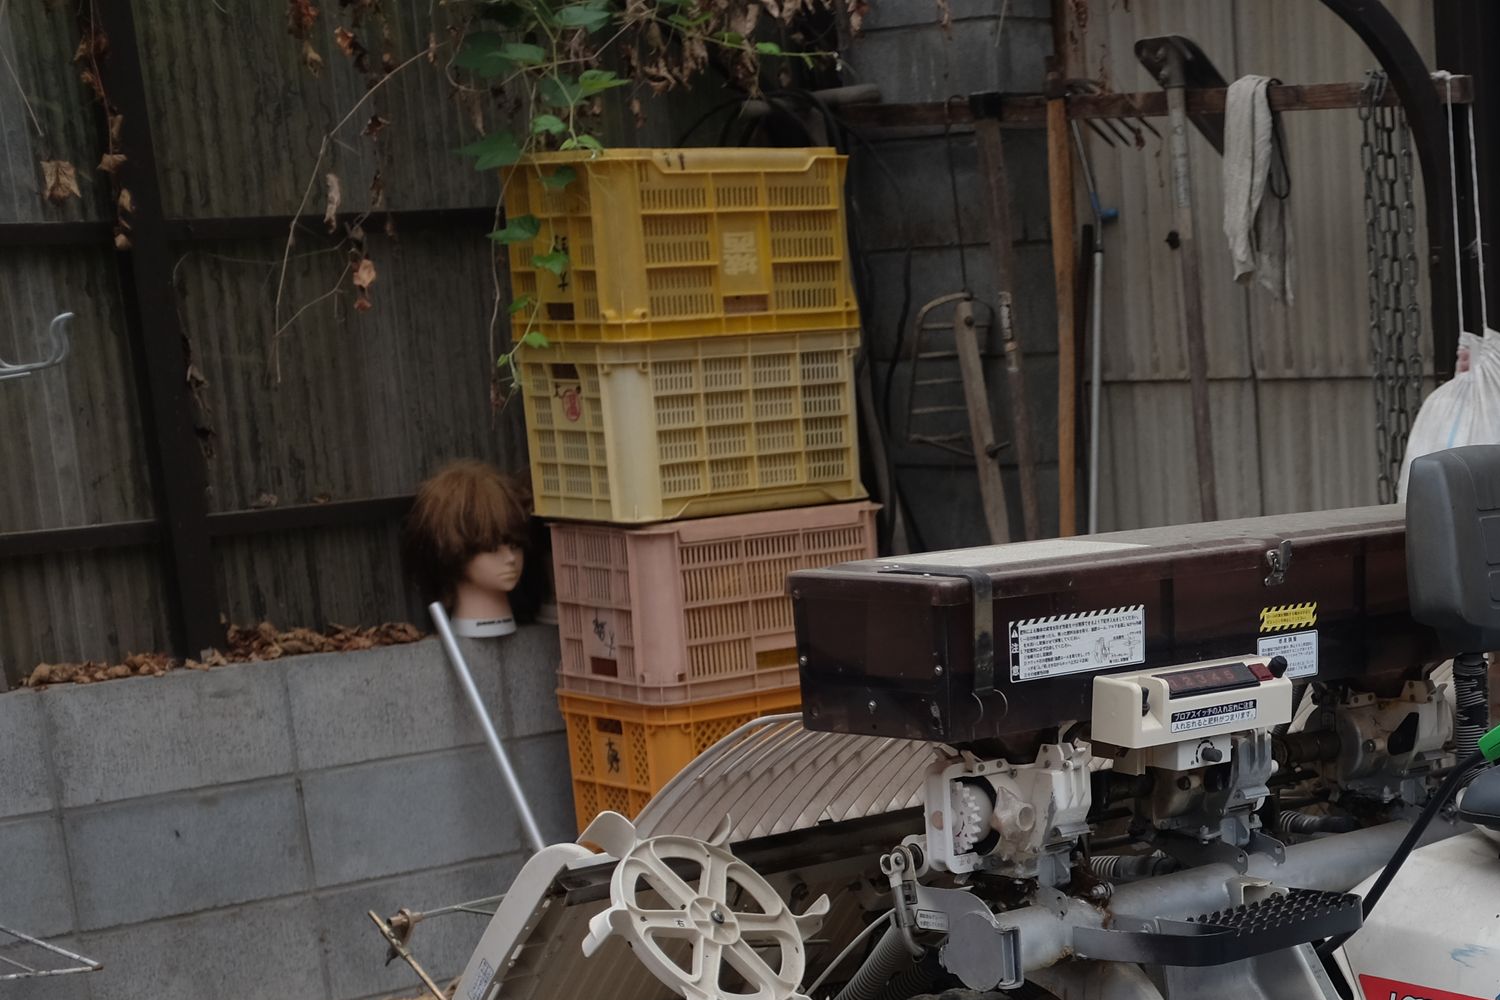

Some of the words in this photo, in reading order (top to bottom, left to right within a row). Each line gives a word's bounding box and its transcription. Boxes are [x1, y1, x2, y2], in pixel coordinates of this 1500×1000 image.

[1174, 711, 1255, 731] 入れ忘れると肥料がつまります。
